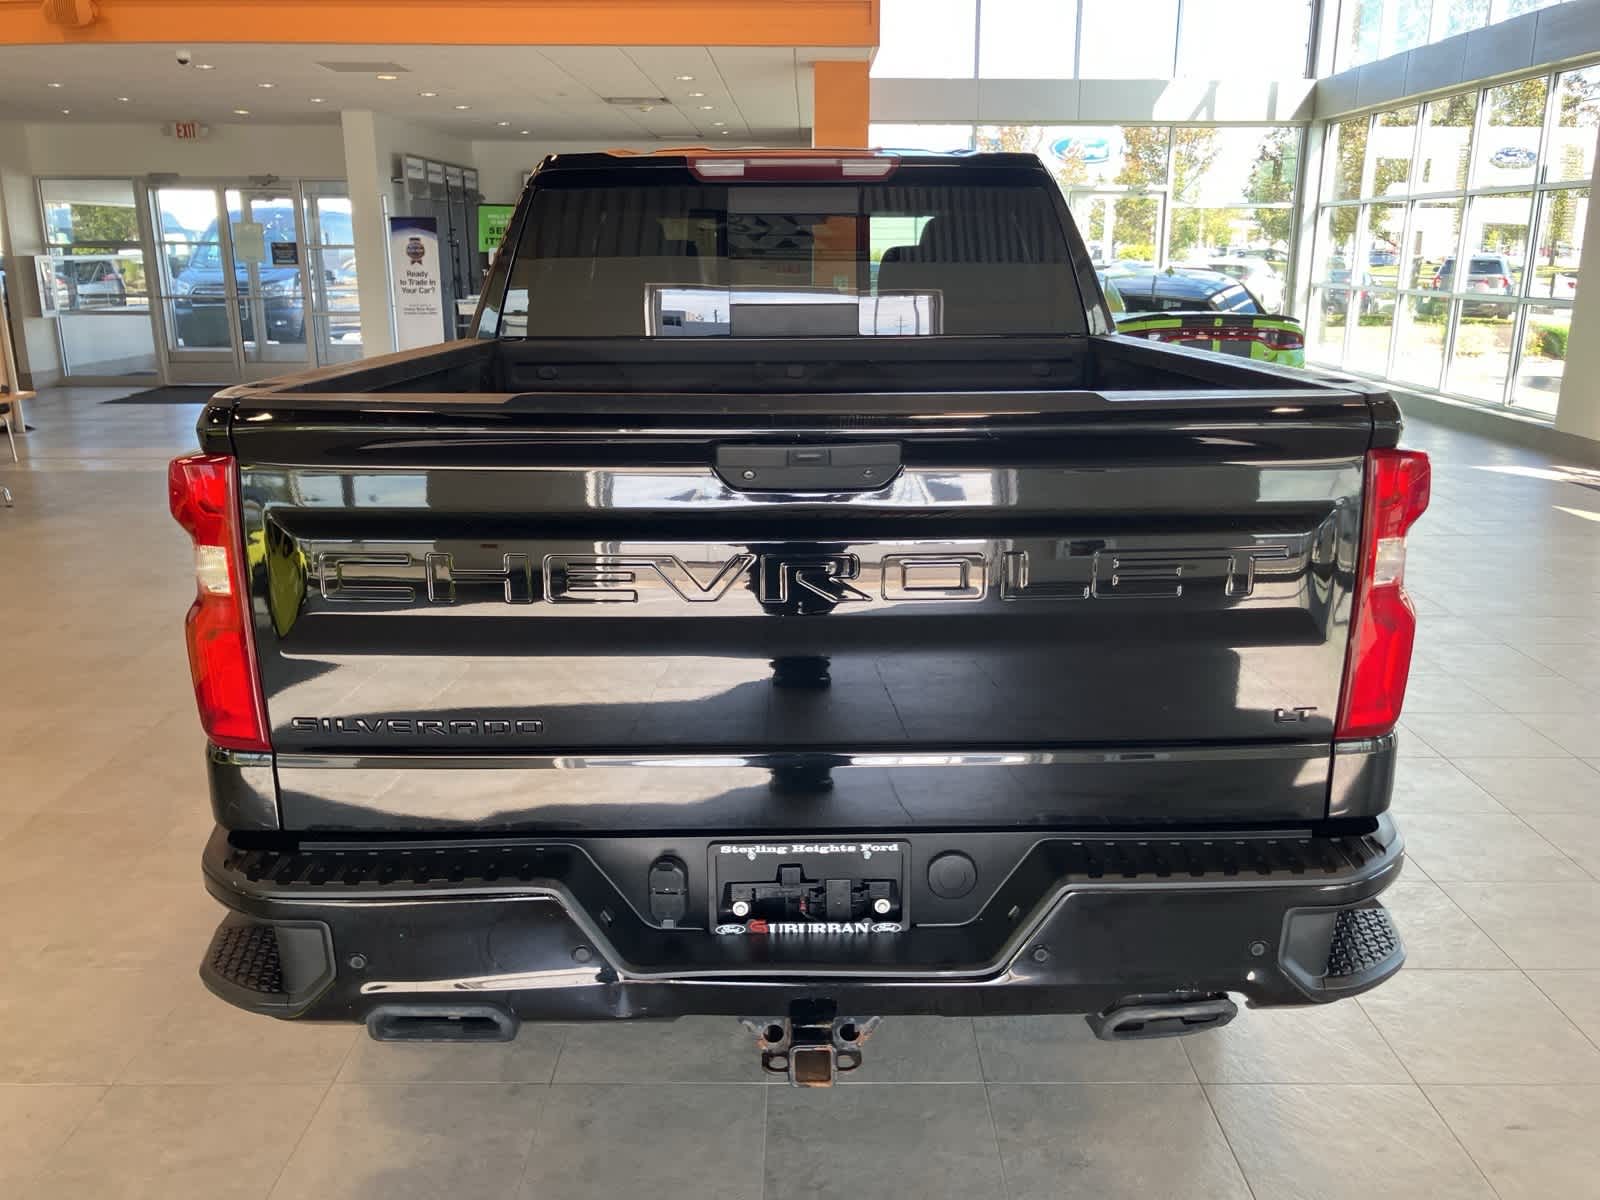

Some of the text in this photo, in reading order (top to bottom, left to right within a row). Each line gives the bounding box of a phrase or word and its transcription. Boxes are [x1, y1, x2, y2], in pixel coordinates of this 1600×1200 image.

[176, 122, 197, 138] EXIT
[406, 270, 428, 279] Ready
[319, 545, 1290, 605] CHEVROLET
[1274, 707, 1318, 723] LT
[291, 716, 545, 736] SILVERADO
[720, 843, 898, 855] Sterling Heights Ford
